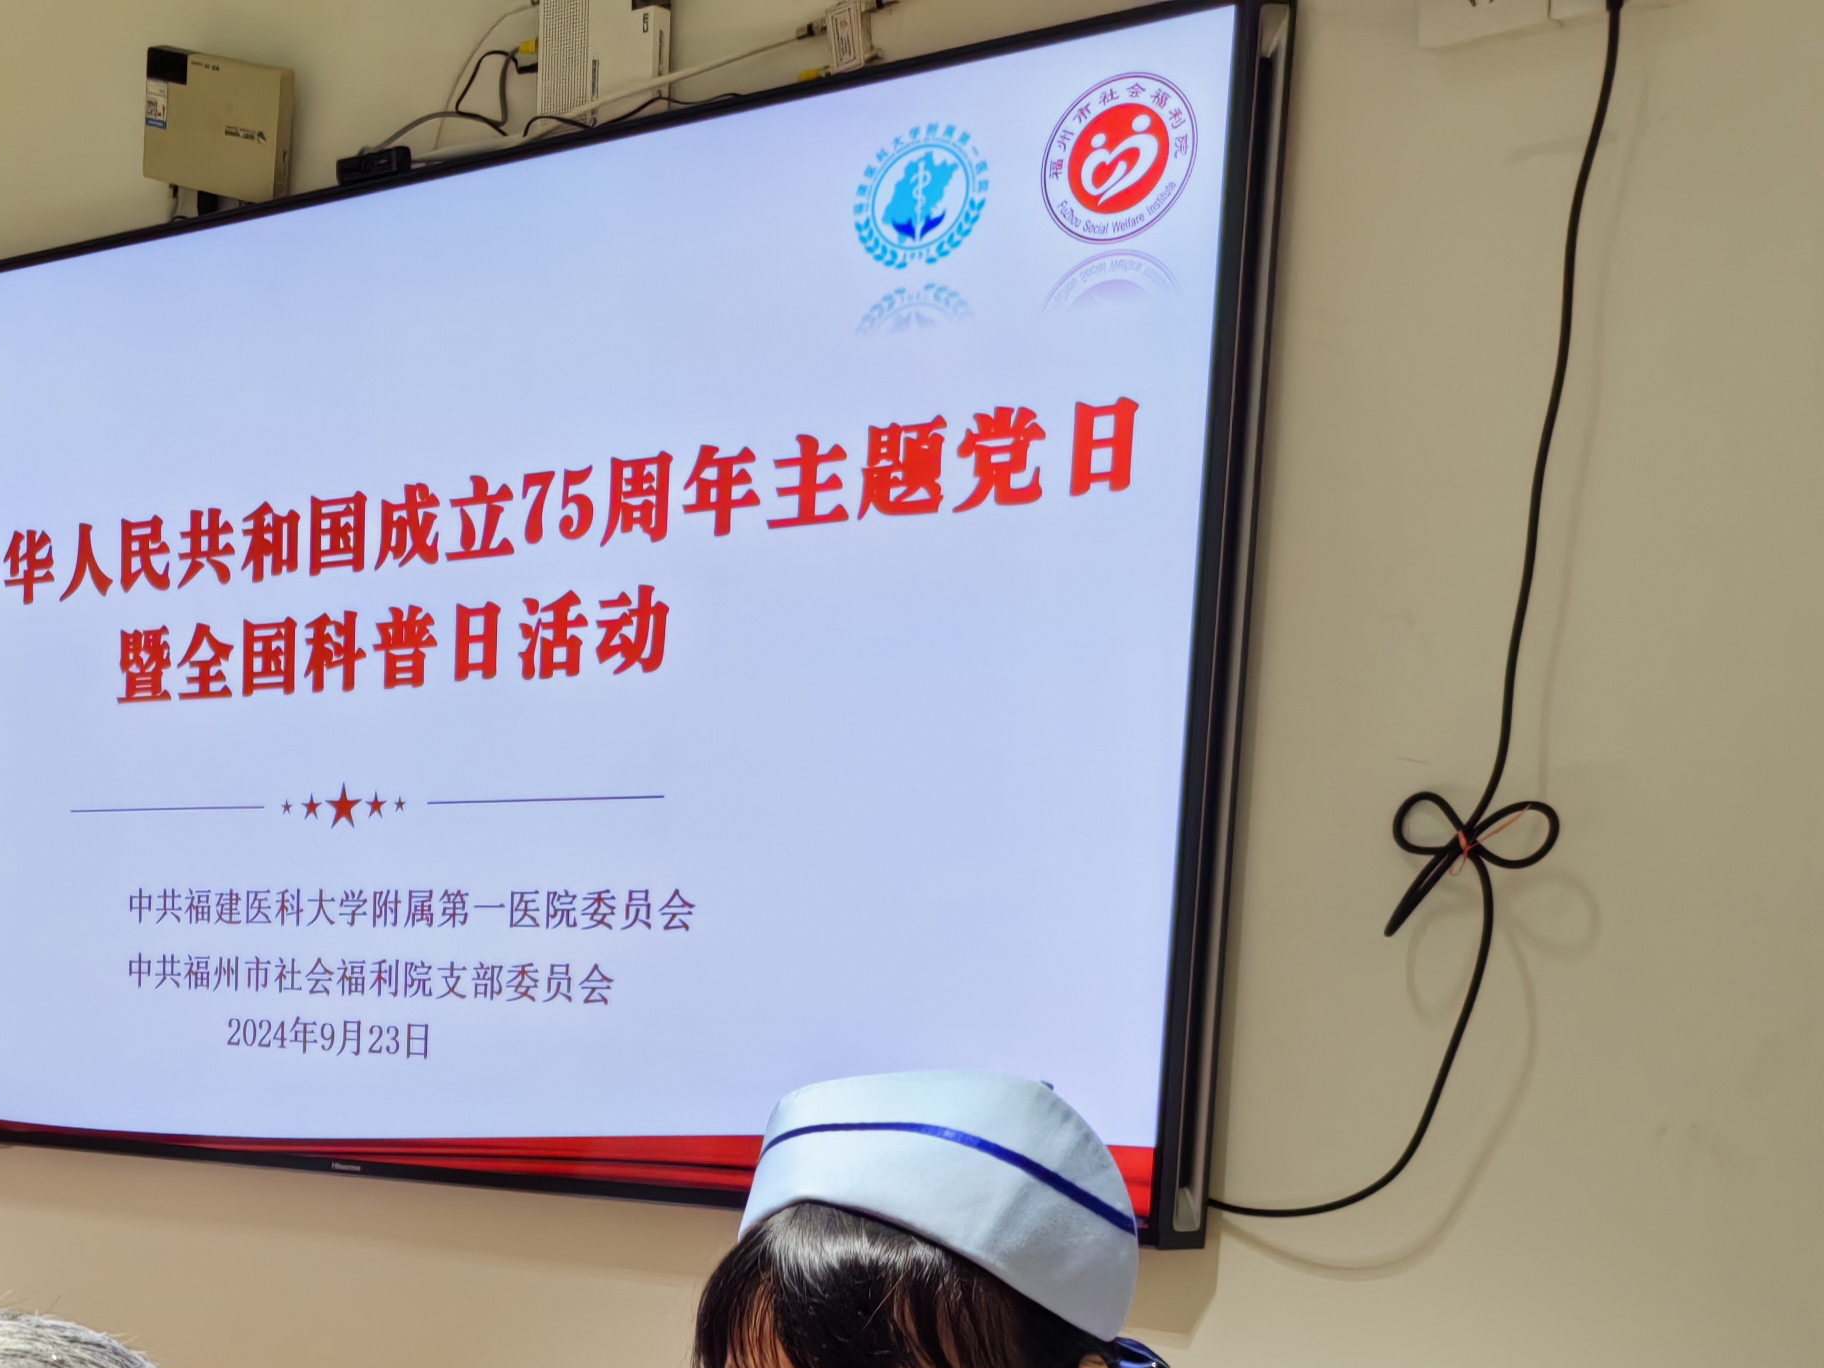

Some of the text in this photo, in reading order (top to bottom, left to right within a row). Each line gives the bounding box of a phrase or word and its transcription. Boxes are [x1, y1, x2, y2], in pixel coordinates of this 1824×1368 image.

[1049, 83, 1188, 180] 福州市社会福利院
[1083, 220, 1109, 235] Social
[1112, 212, 1145, 233] Welfare
[1146, 181, 1176, 216] Institute
[117, 585, 670, 704] 暨全国科普日活动
[129, 887, 696, 932] 中共福建医科大学附属第一医院委员会
[128, 952, 614, 1005] 中共福州市社会福利院支部委员会
[227, 1016, 429, 1059] 2024年9月23日
